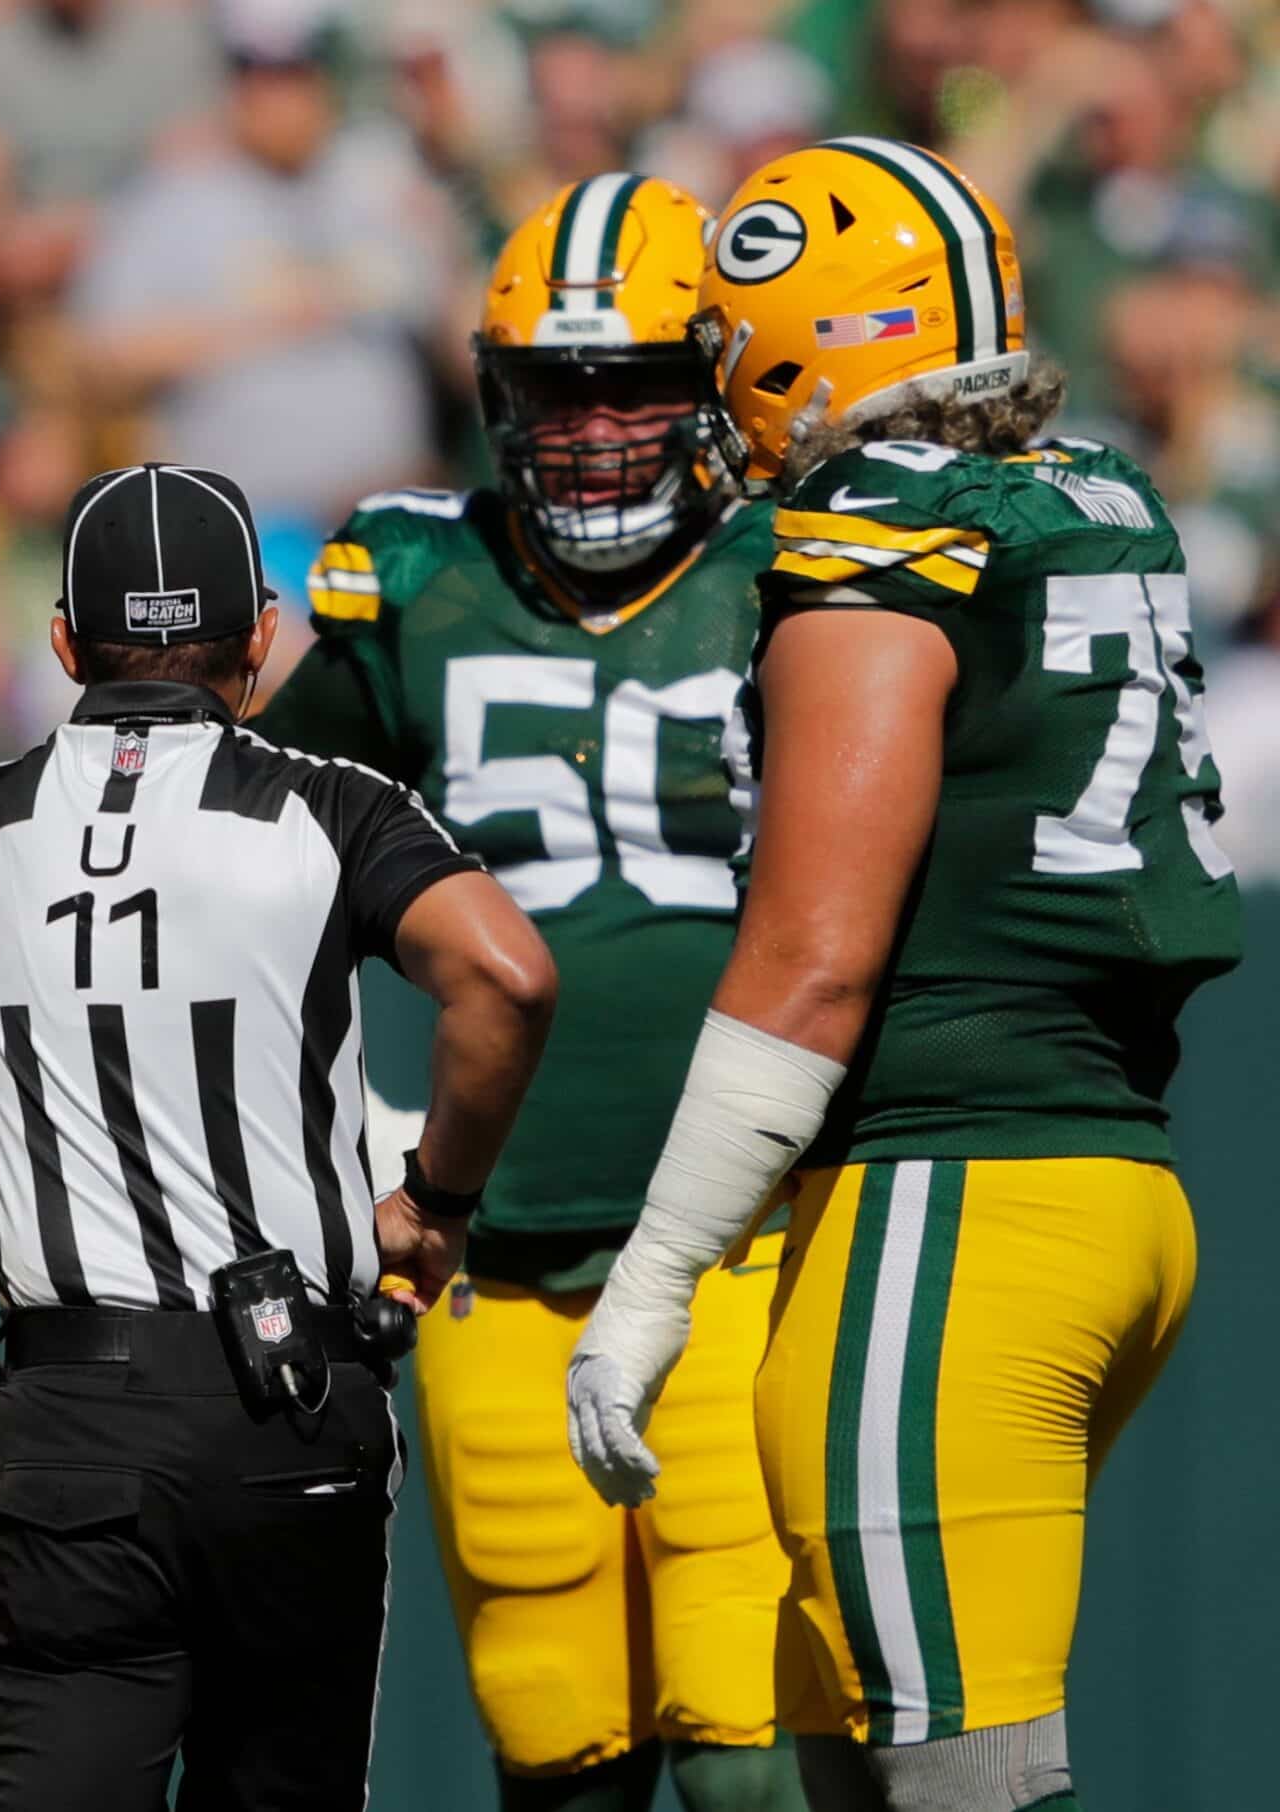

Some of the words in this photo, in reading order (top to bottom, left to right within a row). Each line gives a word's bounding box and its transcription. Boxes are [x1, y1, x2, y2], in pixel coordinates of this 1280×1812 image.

[715, 199, 808, 286] G
[953, 367, 1011, 396] PACKERS
[149, 604, 194, 619] CATCH
[443, 654, 761, 911] 50
[80, 824, 136, 877] U
[46, 887, 159, 990] 11
[258, 1314, 289, 1338] NFL
